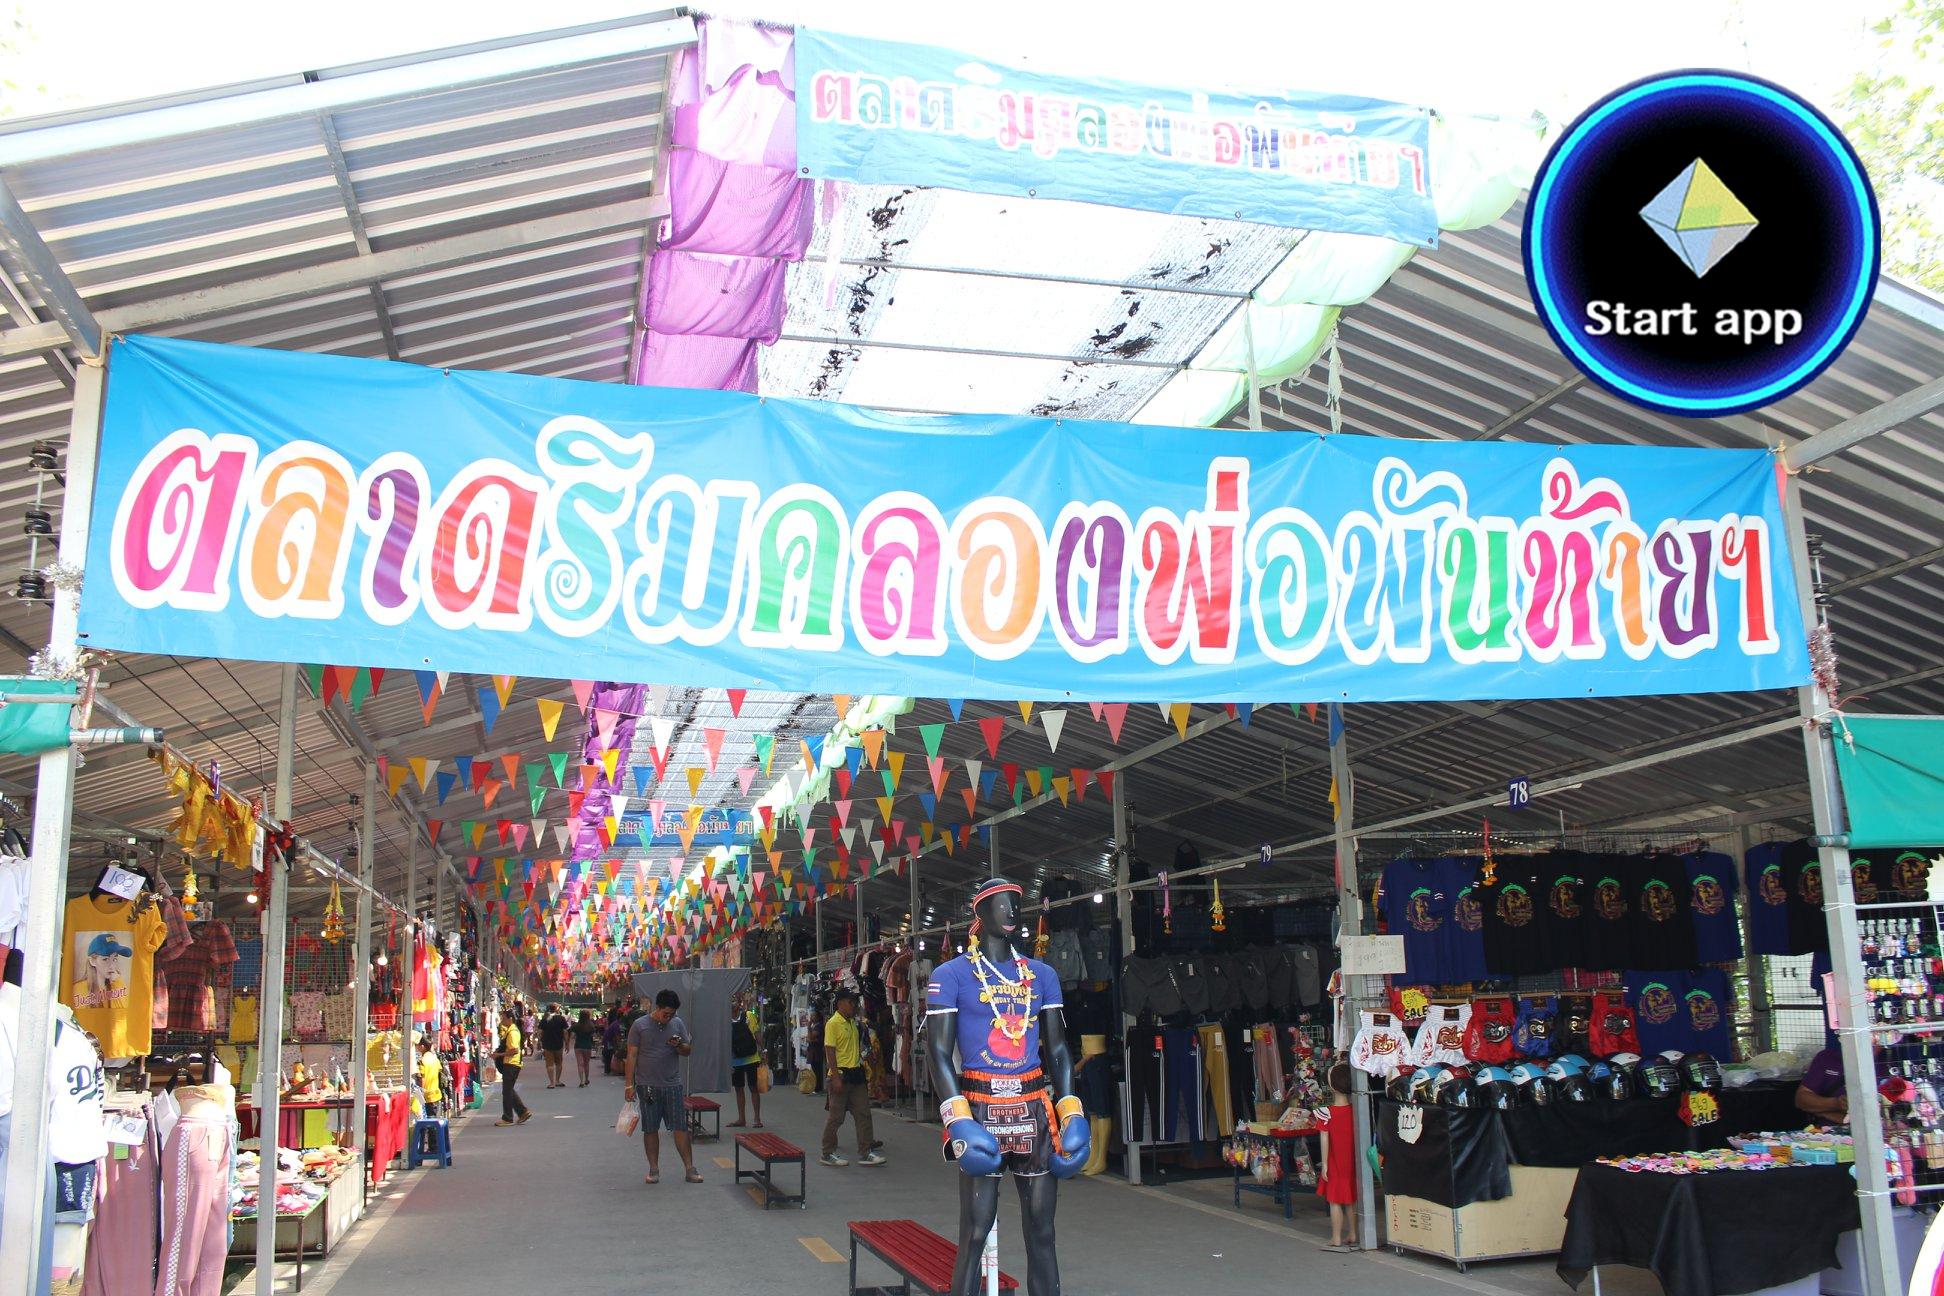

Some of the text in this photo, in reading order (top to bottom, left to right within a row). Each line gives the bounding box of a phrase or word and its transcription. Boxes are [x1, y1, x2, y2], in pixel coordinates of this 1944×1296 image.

[112, 414, 1781, 666] ตลาดริมคลองพ่อพันท้ายฯ
[1510, 781, 1529, 805] 78
[1261, 844, 1272, 863] 79
[1403, 1005, 1428, 1020] SALE
[992, 1107, 1024, 1116] BROTHERS
[1691, 1109, 1719, 1126] SALE
[1401, 1113, 1418, 1130] 120
